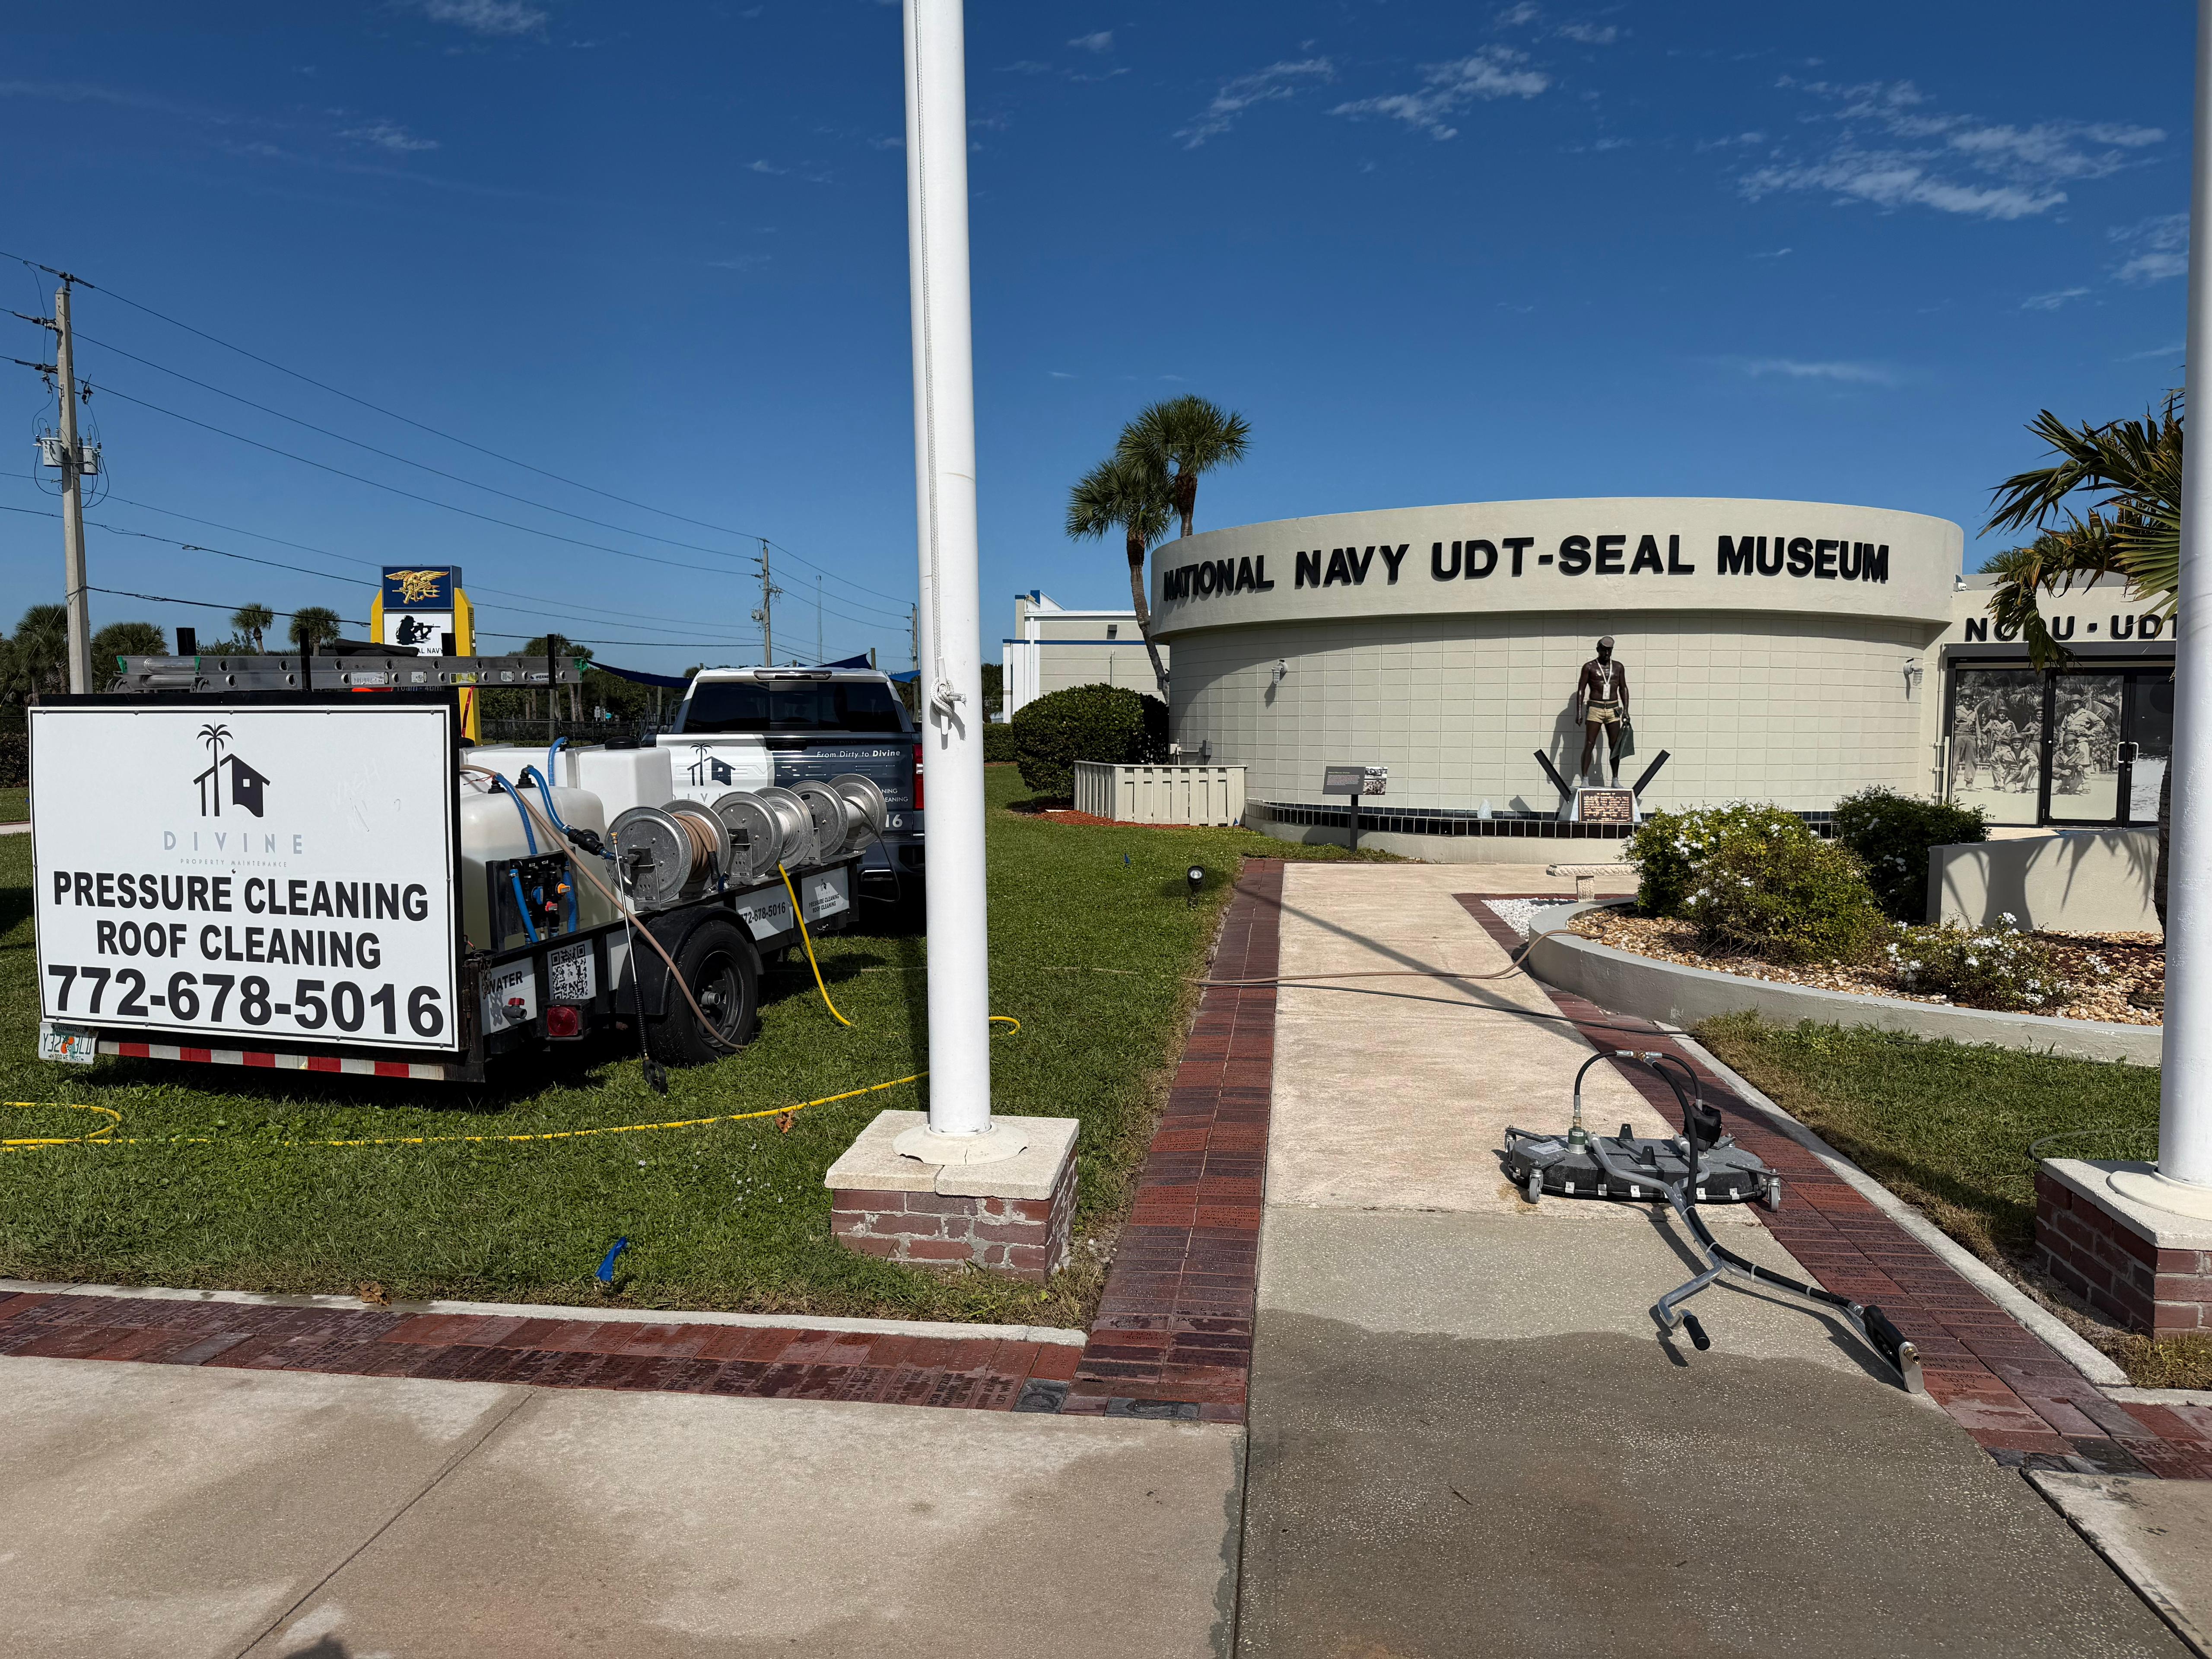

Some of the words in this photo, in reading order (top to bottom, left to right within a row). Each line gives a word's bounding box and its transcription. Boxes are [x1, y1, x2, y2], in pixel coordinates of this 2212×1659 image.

[1164, 555, 1274, 602] NATIONAL
[1296, 543, 1410, 588] NAVY
[1432, 535, 1694, 580] UDT-SEAL
[1718, 535, 1889, 582] MUSEUM
[1965, 616, 2075, 642] NCU
[885, 814, 903, 827] 16
[164, 831, 302, 854] DIVINE
[54, 871, 232, 912] PRESSURE
[245, 877, 428, 922] CLEANING
[809, 897, 824, 908] PRESSURE
[824, 893, 839, 903] CLEANING
[821, 901, 836, 910] CLEANING
[97, 920, 186, 958] ROOF
[200, 925, 381, 969] CLEANING
[48, 964, 444, 1037] 772-678-5016
[273, 1344, 305, 1357] JUDD
[288, 1357, 315, 1367] JOHN
[299, 1356, 327, 1368] CLASS
[933, 1373, 955, 1392] KITZLER
[926, 1393, 943, 1404] BOB
[953, 1392, 969, 1403] UDT
[992, 1394, 1008, 1405] UDT
